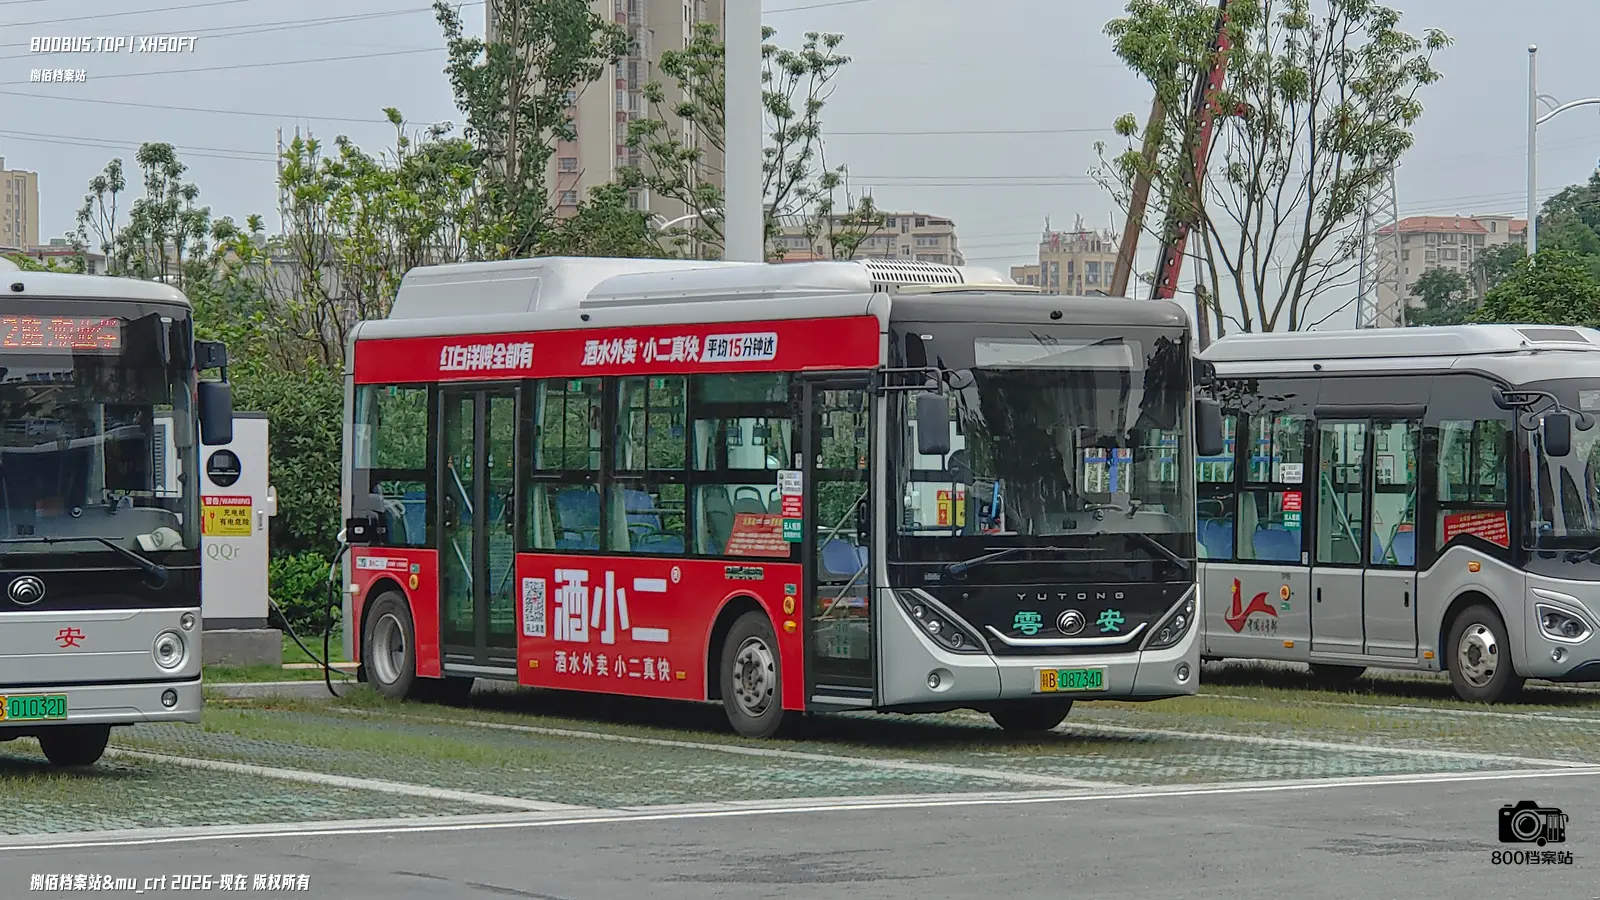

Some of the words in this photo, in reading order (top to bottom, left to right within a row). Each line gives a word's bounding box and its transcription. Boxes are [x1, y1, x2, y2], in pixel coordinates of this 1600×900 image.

[439, 341, 535, 371] 红白洋啤全都有
[707, 337, 775, 358] 平均15分钟达
[554, 568, 670, 645] 酒小二
[1016, 592, 1125, 600] YUTONG
[1096, 609, 1126, 632] 安
[55, 627, 86, 648] 安
[554, 650, 609, 677] 酒水外卖
[614, 655, 671, 682] 小二真快
